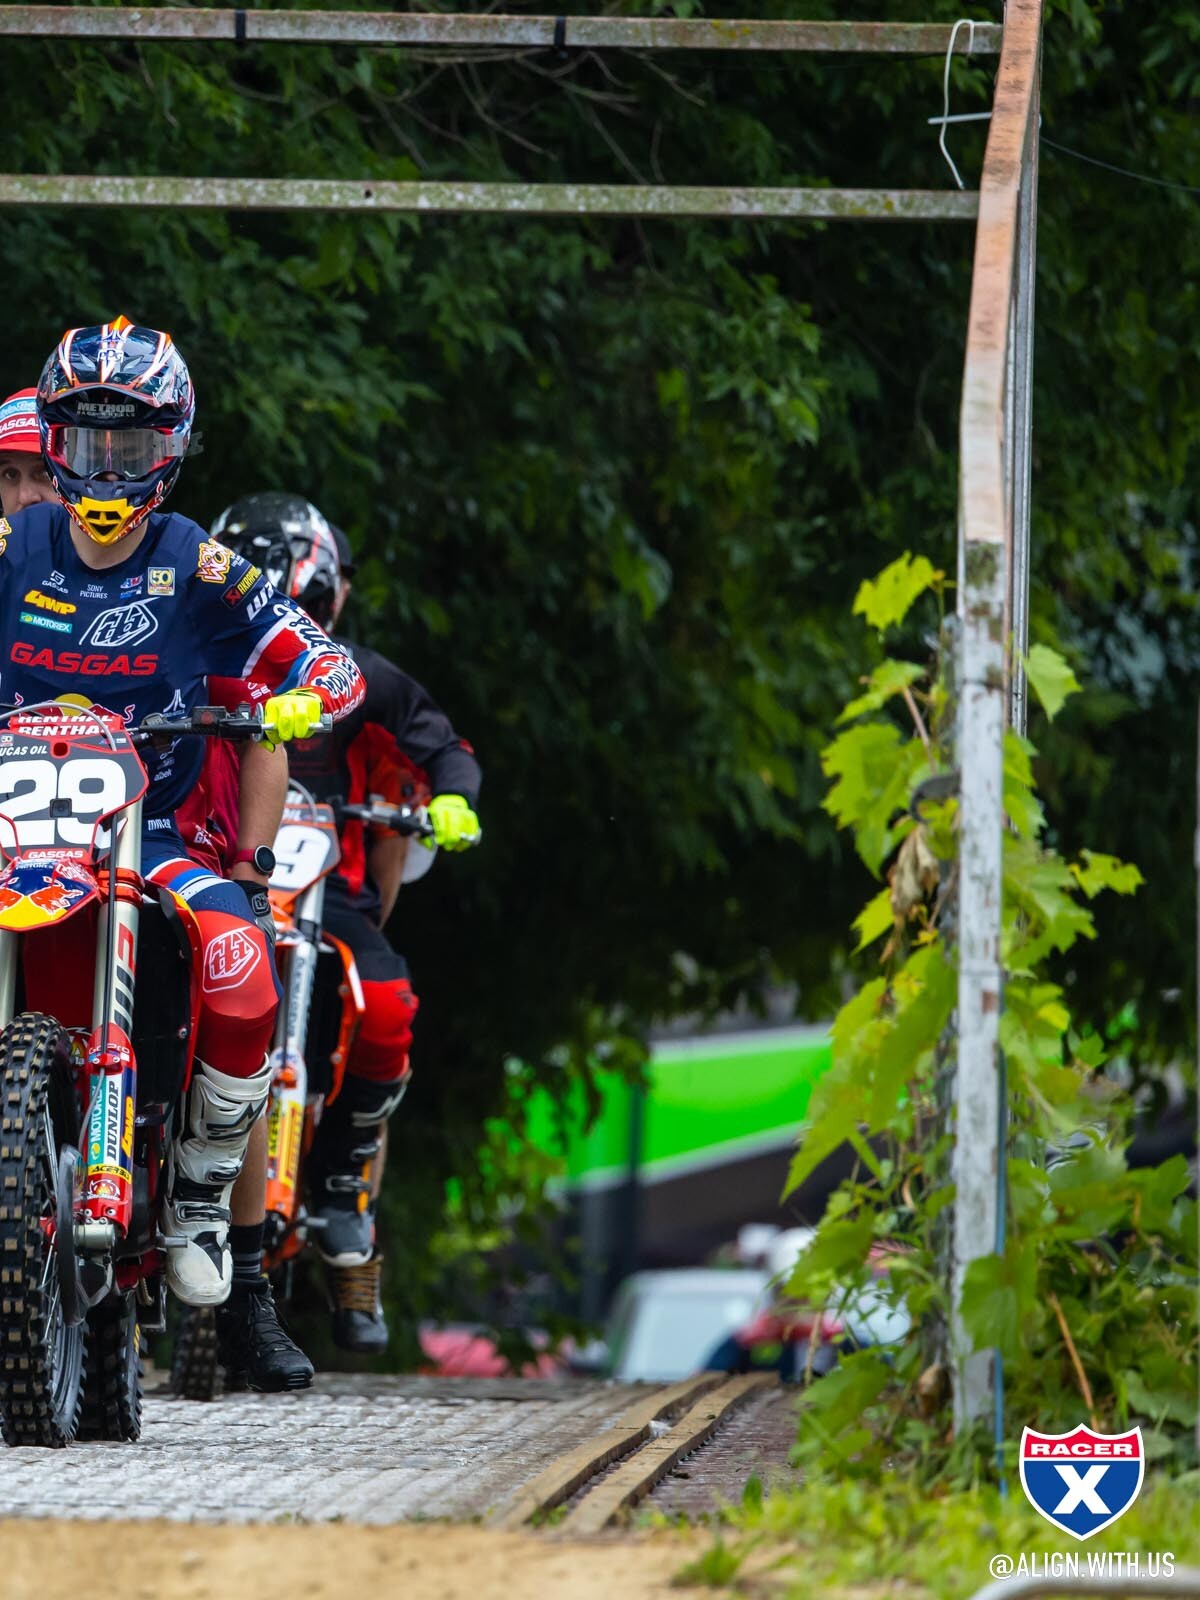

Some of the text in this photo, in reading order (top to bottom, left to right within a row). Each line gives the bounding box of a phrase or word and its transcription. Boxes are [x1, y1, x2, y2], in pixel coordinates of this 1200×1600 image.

[77, 402, 136, 413] METHOD
[150, 569, 172, 586] 50
[87, 584, 104, 592] SONY
[80, 591, 108, 599] PICTURES
[31, 616, 70, 632] MOTOREX
[10, 642, 160, 676] GASGAS
[30, 745, 48, 755] OIL
[28, 850, 84, 859] GASGAS
[106, 1081, 119, 1161] DUNLOP
